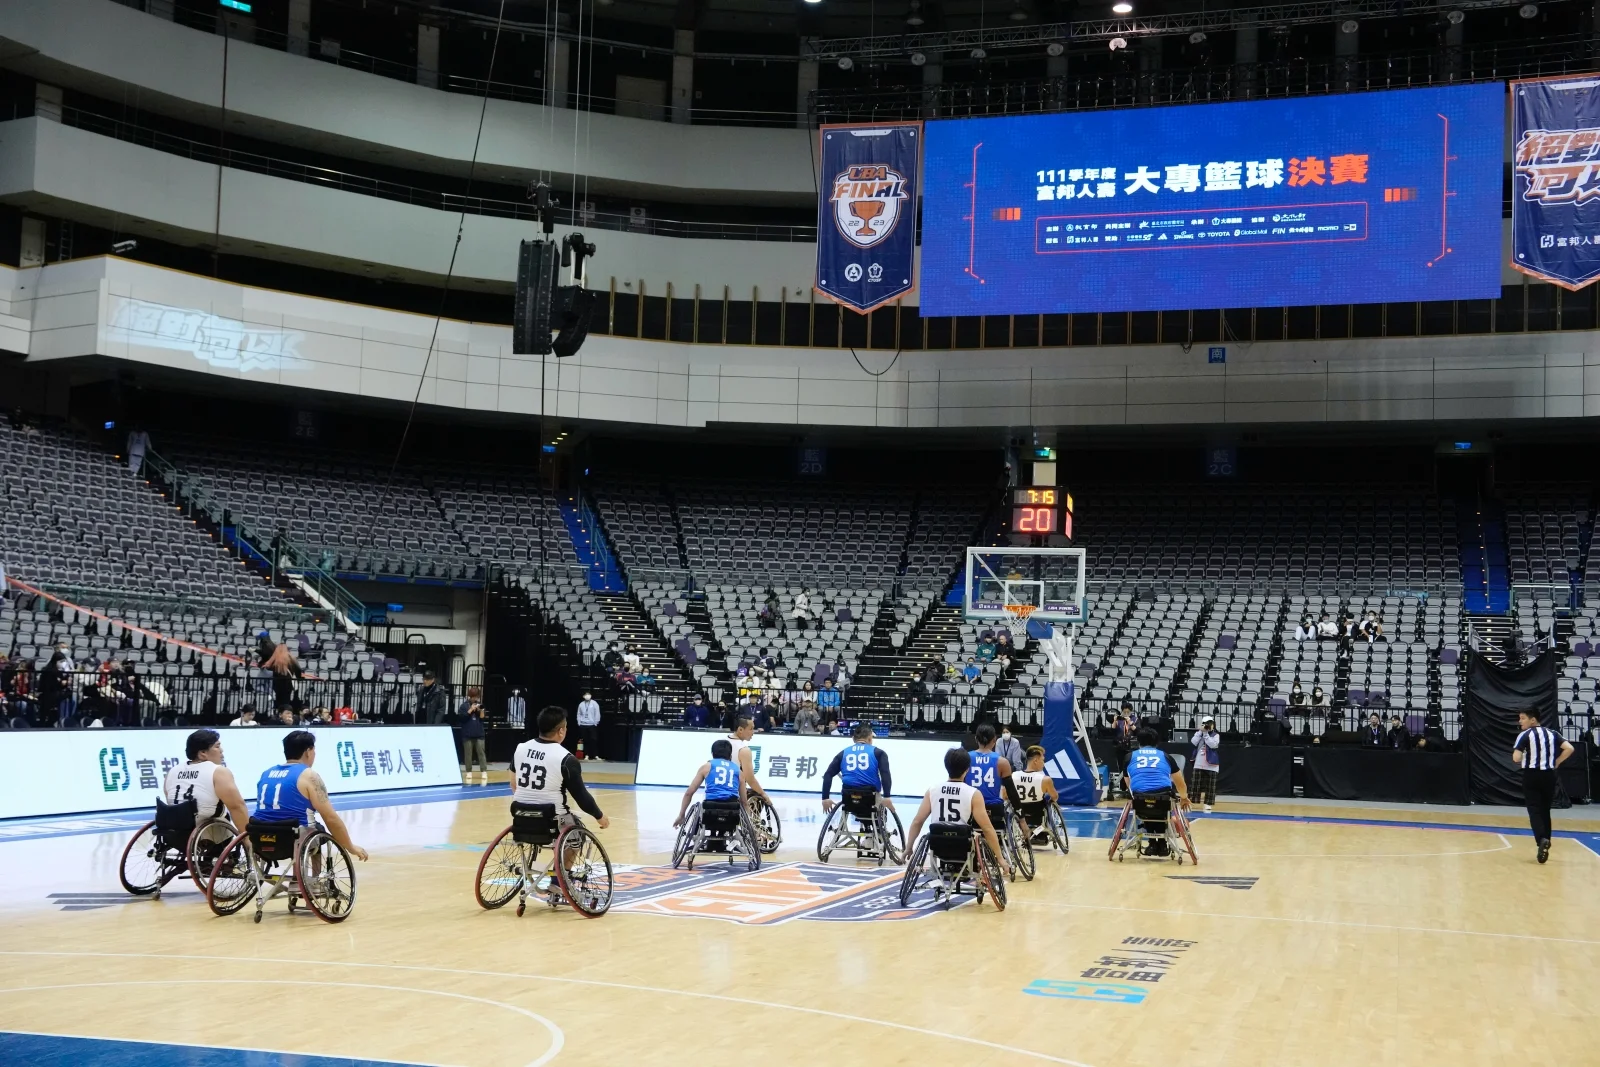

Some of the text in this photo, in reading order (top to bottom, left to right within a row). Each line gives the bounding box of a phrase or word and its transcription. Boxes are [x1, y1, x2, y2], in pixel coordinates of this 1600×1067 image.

[1036, 167, 1116, 183] 111學年度
[1124, 154, 1368, 195] 大專籃球決賽
[835, 181, 904, 199] FINAL
[1036, 182, 1116, 201] 富邦人壽
[1212, 348, 1222, 360] 南
[801, 462, 822, 473] 2D
[1209, 464, 1232, 474] 2C
[1028, 490, 1054, 504] 7:15
[1020, 508, 1050, 531] 20
[361, 748, 424, 776] 富邦人壽
[527, 748, 546, 760] TENG
[846, 752, 870, 771] 99
[1136, 756, 1160, 768] 37
[178, 770, 200, 780] CHANG
[268, 770, 289, 778] WANG
[518, 762, 547, 790] 33
[714, 766, 734, 788] 31
[971, 766, 994, 788] 34
[174, 784, 195, 804] 14
[259, 784, 282, 810] 11
[942, 786, 960, 796] CHEN
[1016, 786, 1037, 801] 34
[938, 798, 960, 822] 15
